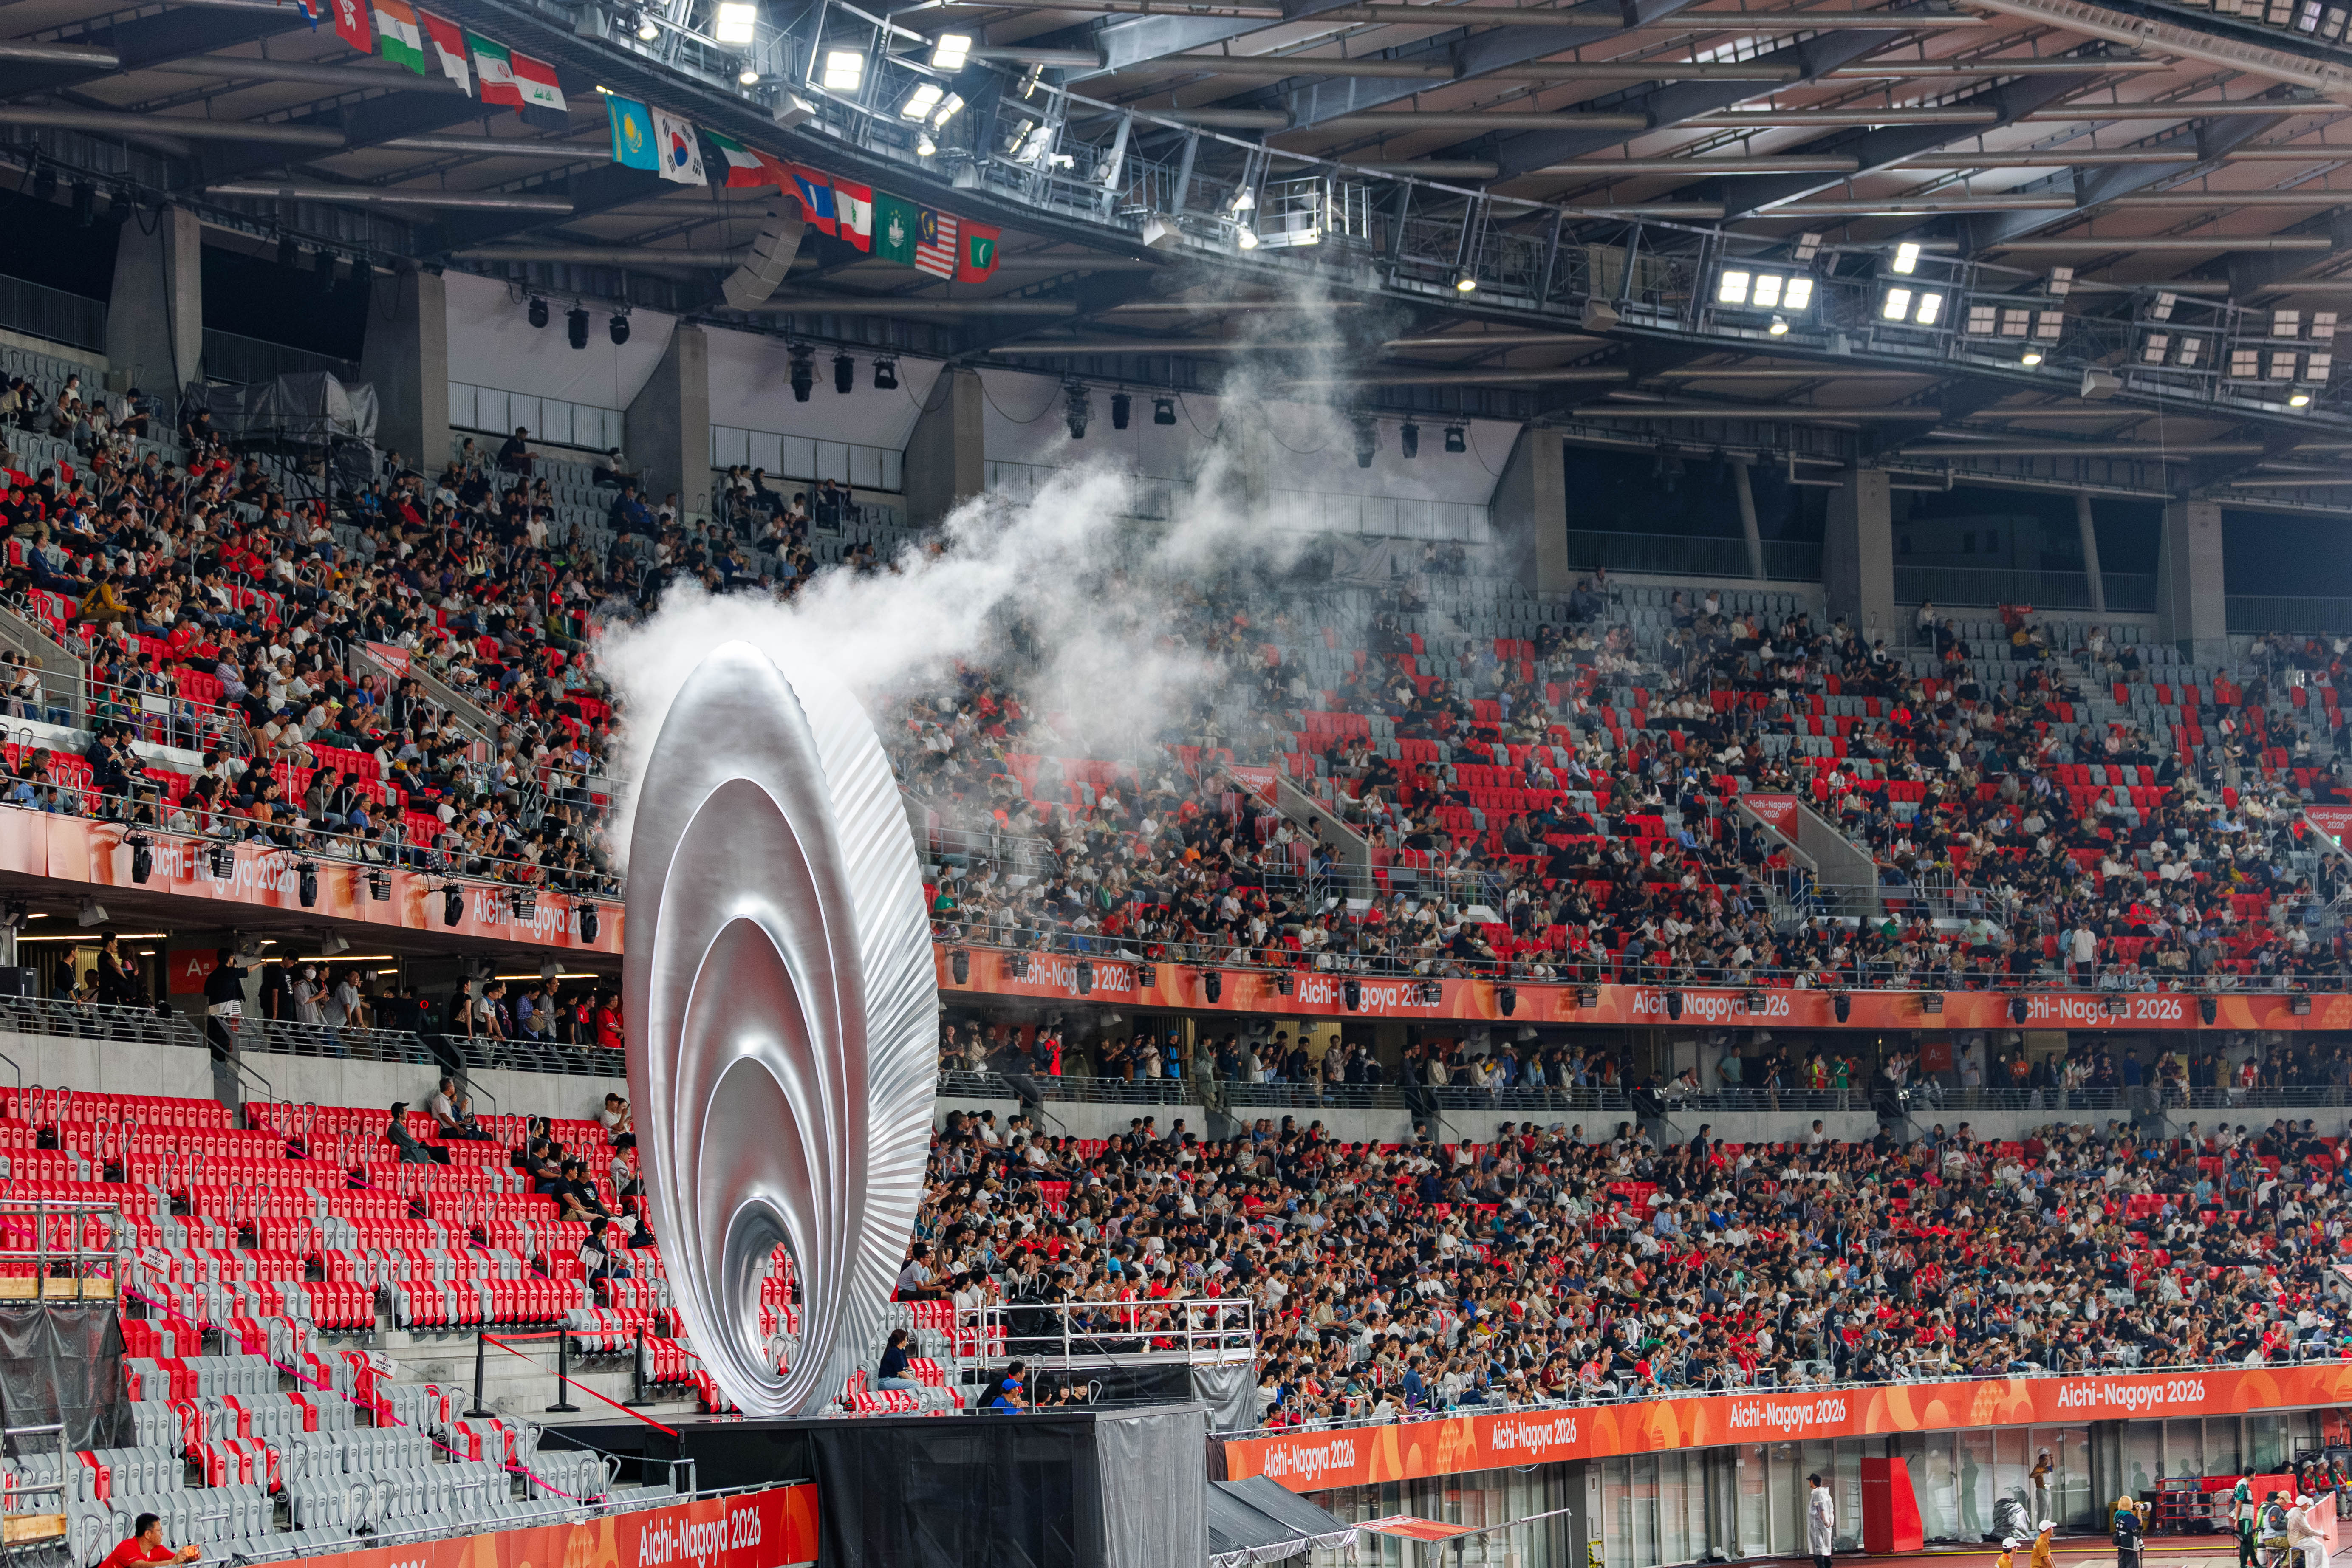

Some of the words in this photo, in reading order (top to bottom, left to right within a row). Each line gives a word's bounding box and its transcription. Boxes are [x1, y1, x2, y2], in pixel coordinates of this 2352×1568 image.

[1749, 800, 1792, 811] Aichi-Nagoya
[1764, 810, 1779, 818] 2026
[258, 856, 294, 893] 2026
[186, 958, 203, 976] A
[1101, 966, 1131, 992] 2026
[2136, 999, 2182, 1020] 2026
[1929, 1048, 1937, 1061] A
[2058, 1382, 2163, 1411] Aichi-Nagoya
[2167, 1379, 2205, 1403] 2026
[1730, 1400, 1813, 1433] Aichi-Nagoya
[1815, 1398, 1846, 1424] 2026
[1492, 1419, 1553, 1455] Aichi-Nagoya
[1555, 1417, 1577, 1445] 2026
[1264, 1443, 1329, 1481] Aichi-Nagoya
[1331, 1438, 1355, 1469] 2026
[639, 1516, 728, 1568] Aichi-Nagoya
[731, 1506, 761, 1550] 2026
